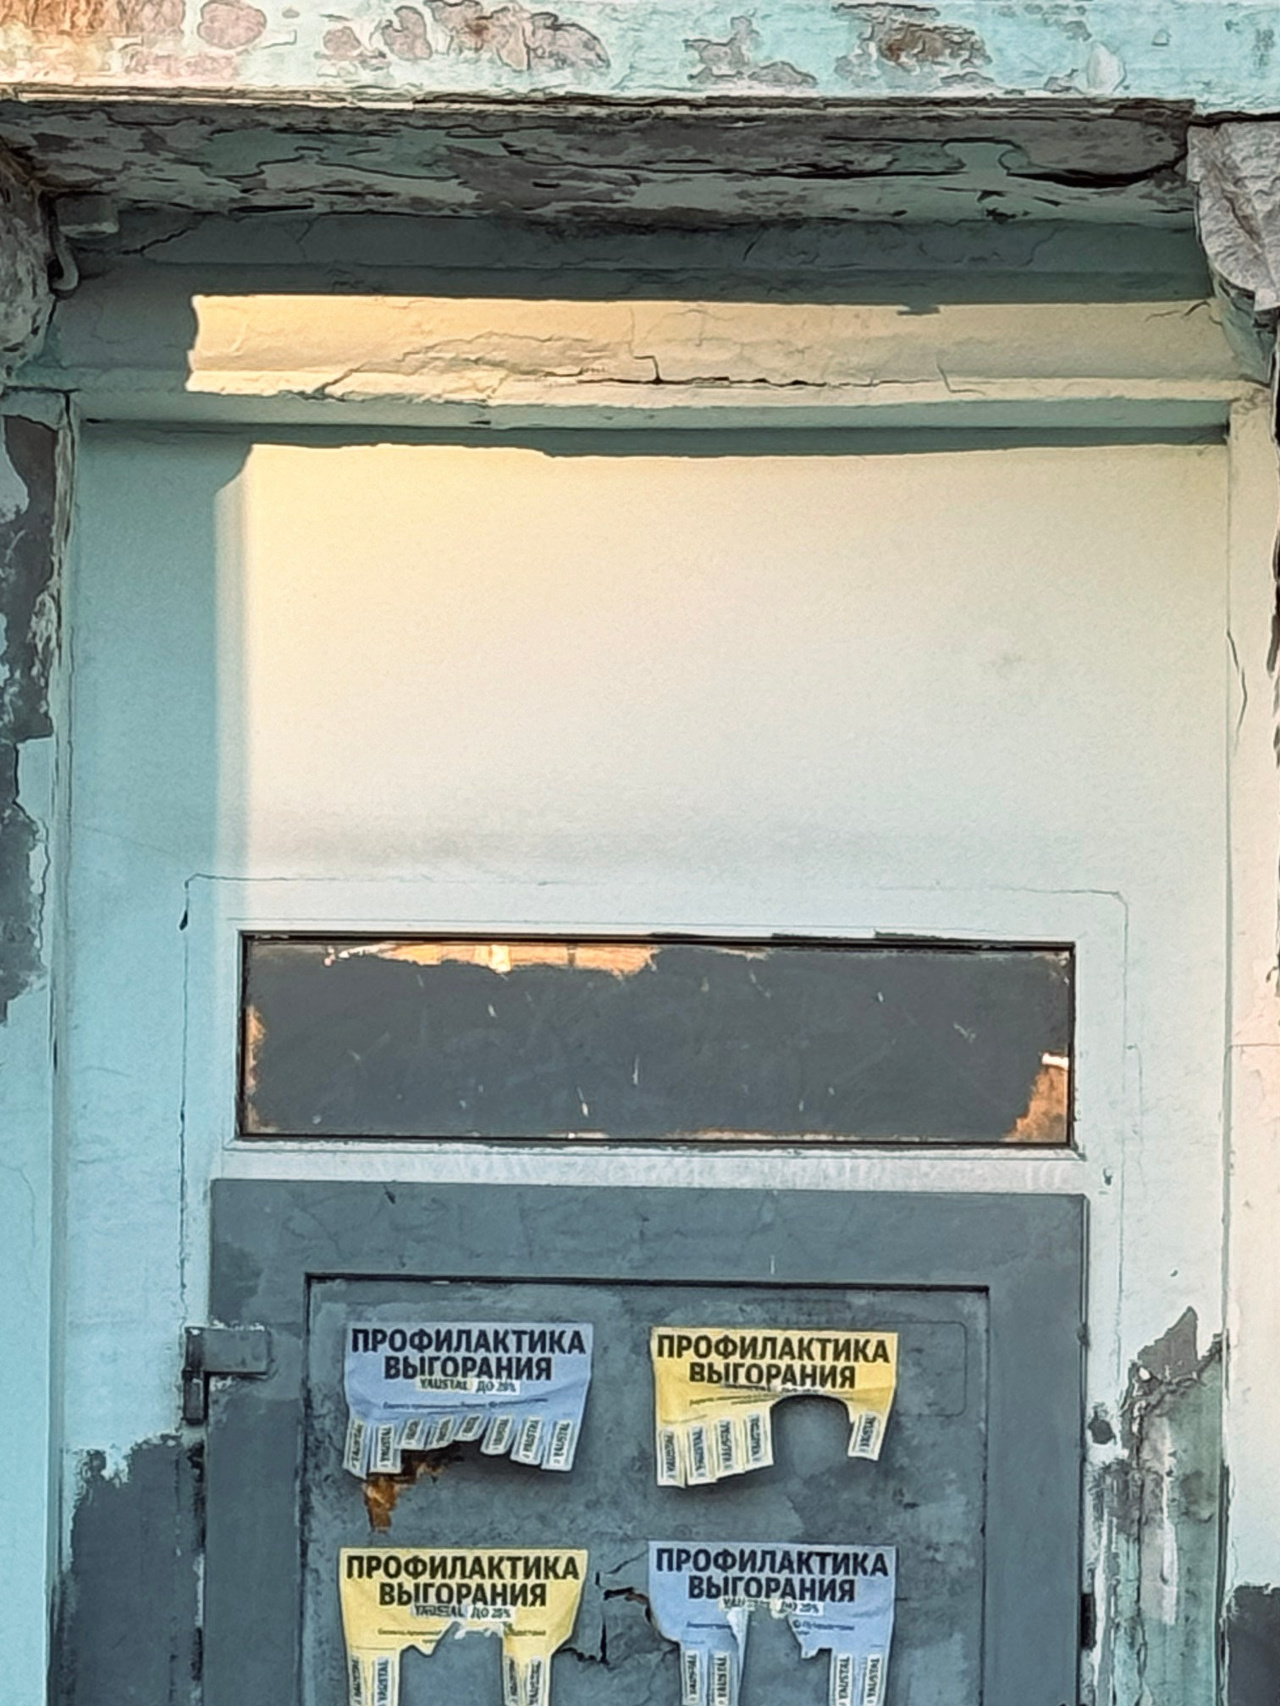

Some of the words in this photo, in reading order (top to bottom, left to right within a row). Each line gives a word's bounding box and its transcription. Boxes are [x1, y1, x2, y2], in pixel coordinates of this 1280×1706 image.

[351, 1328, 587, 1354] ПРОФИЛАКТИКА
[657, 1334, 890, 1364] ПРОФИЛАКТИКА
[384, 1356, 551, 1381] ВЫГОРАНИЯ
[689, 1362, 856, 1389] ВЫГОРАНИЯ
[346, 1555, 580, 1580] ПРОФИЛАКТИКА
[656, 1548, 889, 1577] ПРОФИЛАКТИКА
[379, 1583, 547, 1607] ВЫГОРАНИЯ
[688, 1575, 856, 1602] ВЫГОРАНИЯ
